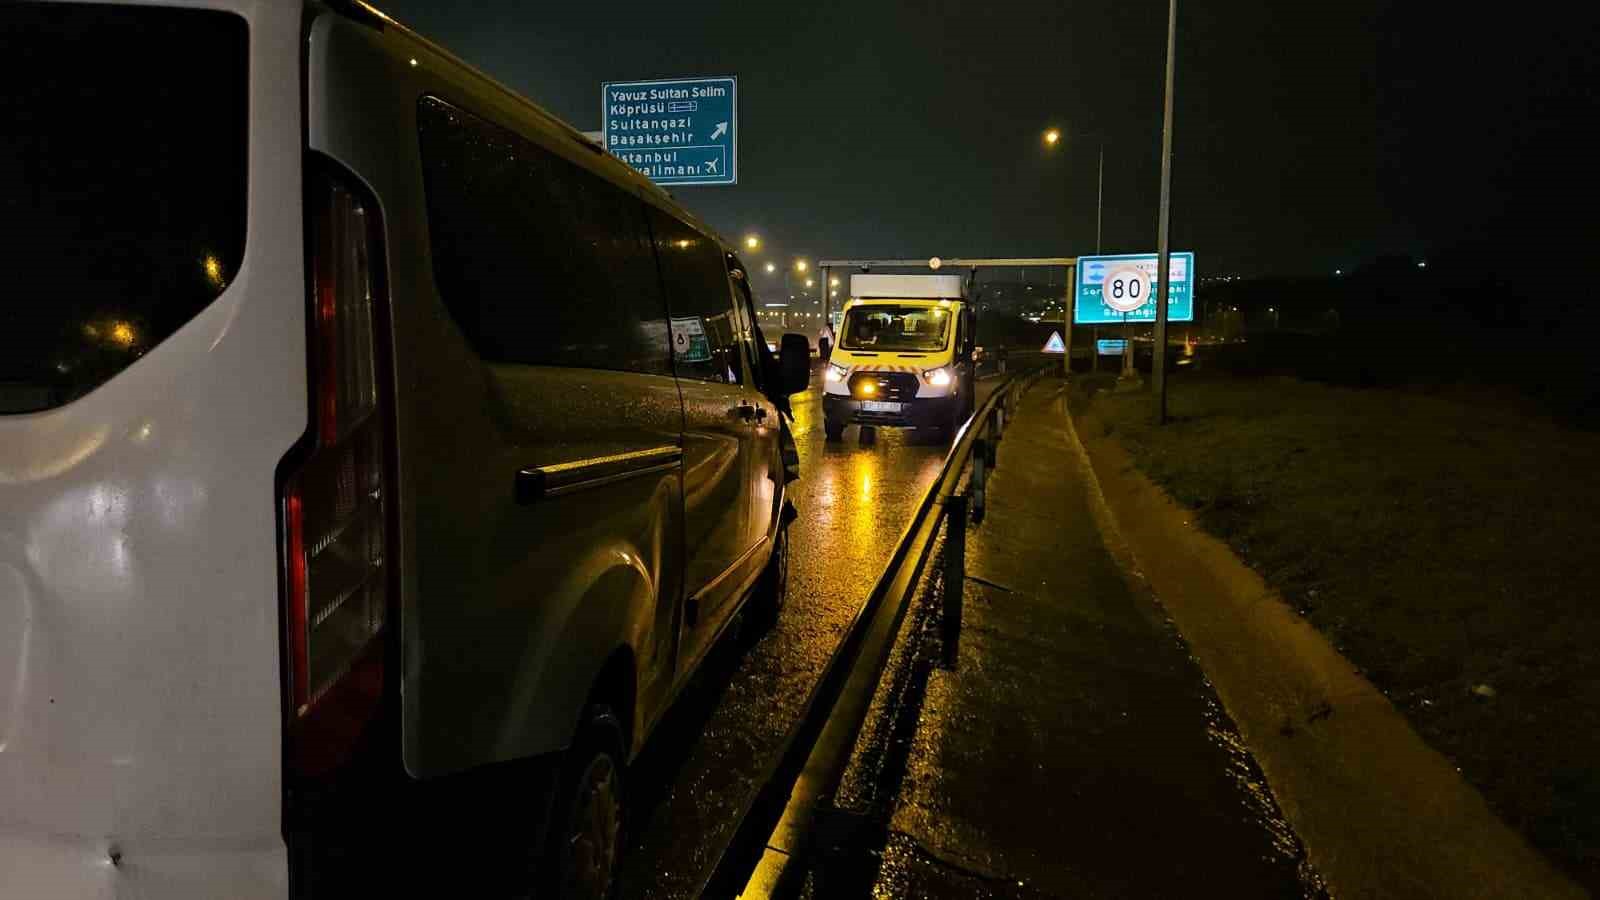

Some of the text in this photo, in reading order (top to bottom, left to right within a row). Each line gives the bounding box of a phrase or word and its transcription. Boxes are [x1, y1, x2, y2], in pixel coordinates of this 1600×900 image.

[611, 86, 726, 102] Yavuz Sultan Selim
[610, 102, 665, 117] Köprüsü
[610, 117, 692, 131] Sultangazi
[610, 132, 694, 147] Başakşehir
[1113, 279, 1141, 298] 80
